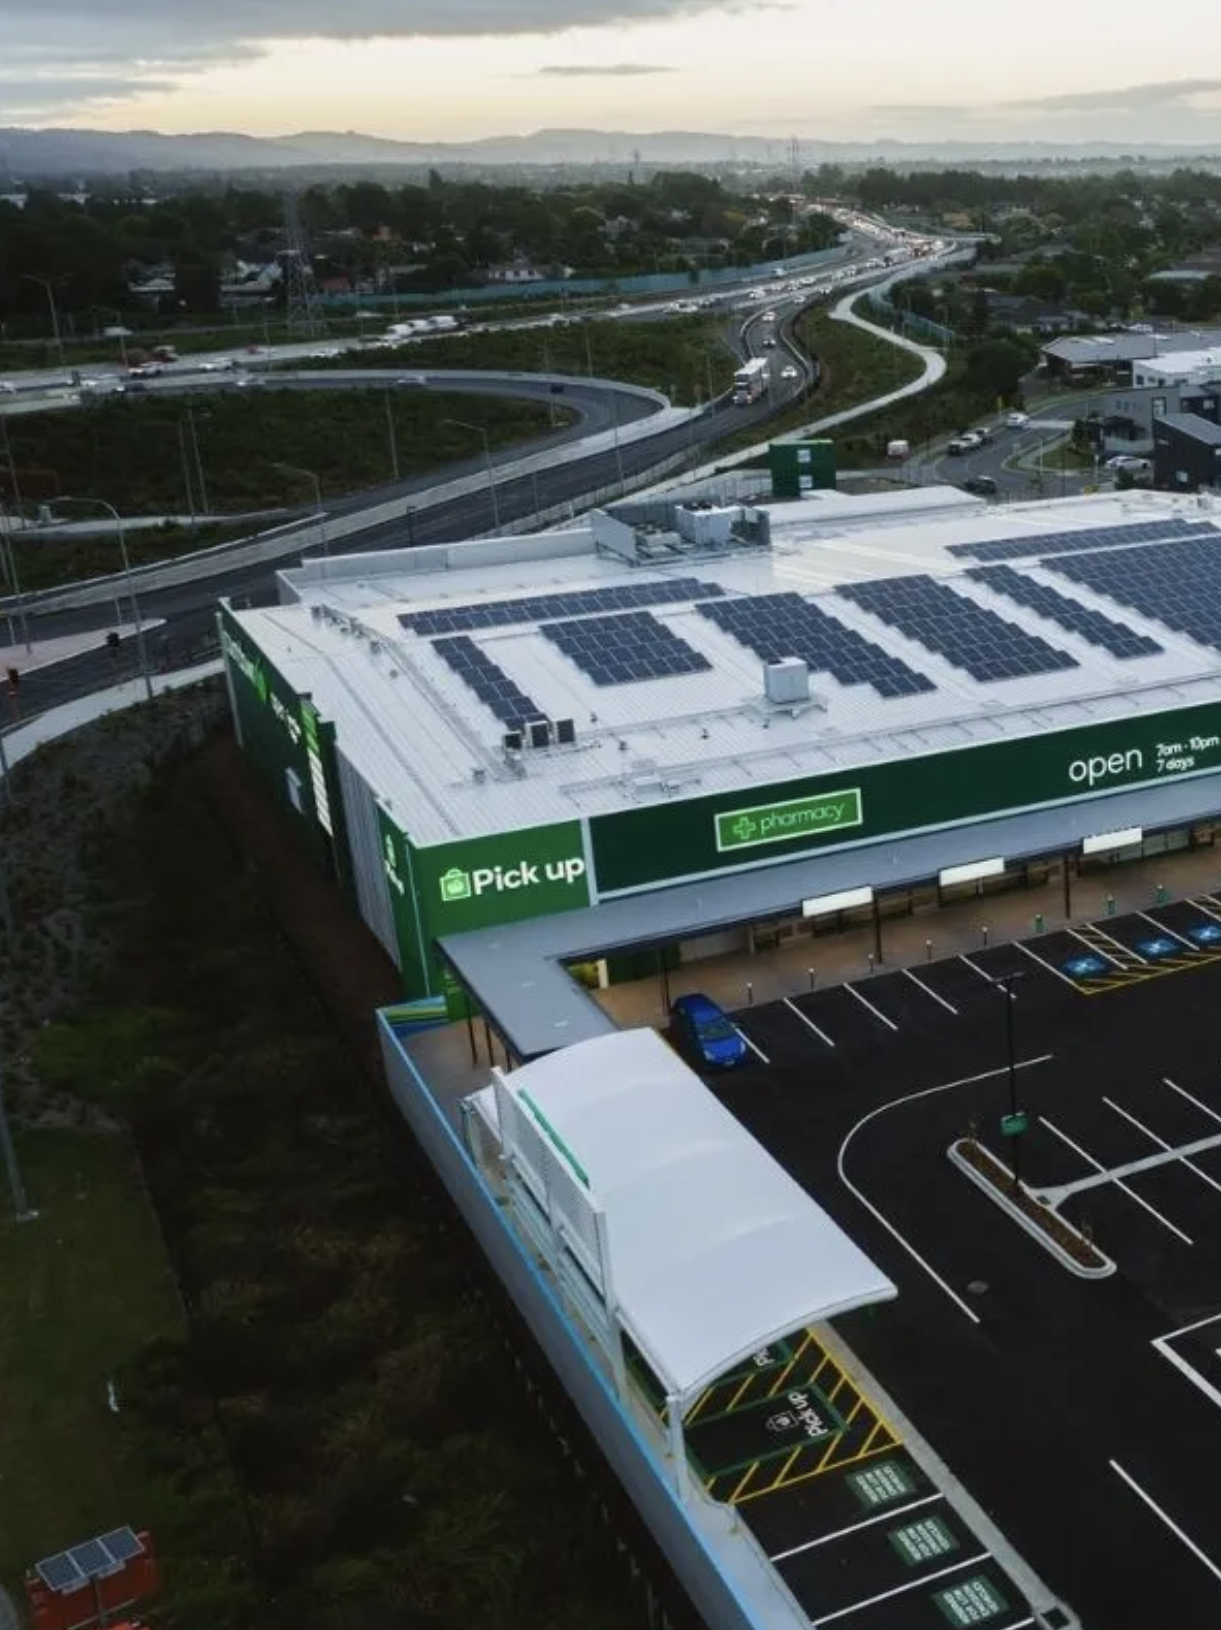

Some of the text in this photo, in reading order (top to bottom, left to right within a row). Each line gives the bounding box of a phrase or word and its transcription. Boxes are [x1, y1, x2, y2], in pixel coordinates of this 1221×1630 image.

[1155, 743, 1183, 757] 7am
[1189, 735, 1220, 751] 10pm
[1068, 748, 1142, 786] open
[1155, 756, 1195, 773] 7 days
[761, 803, 845, 836] pharmacy
[472, 857, 585, 895] Pick up
